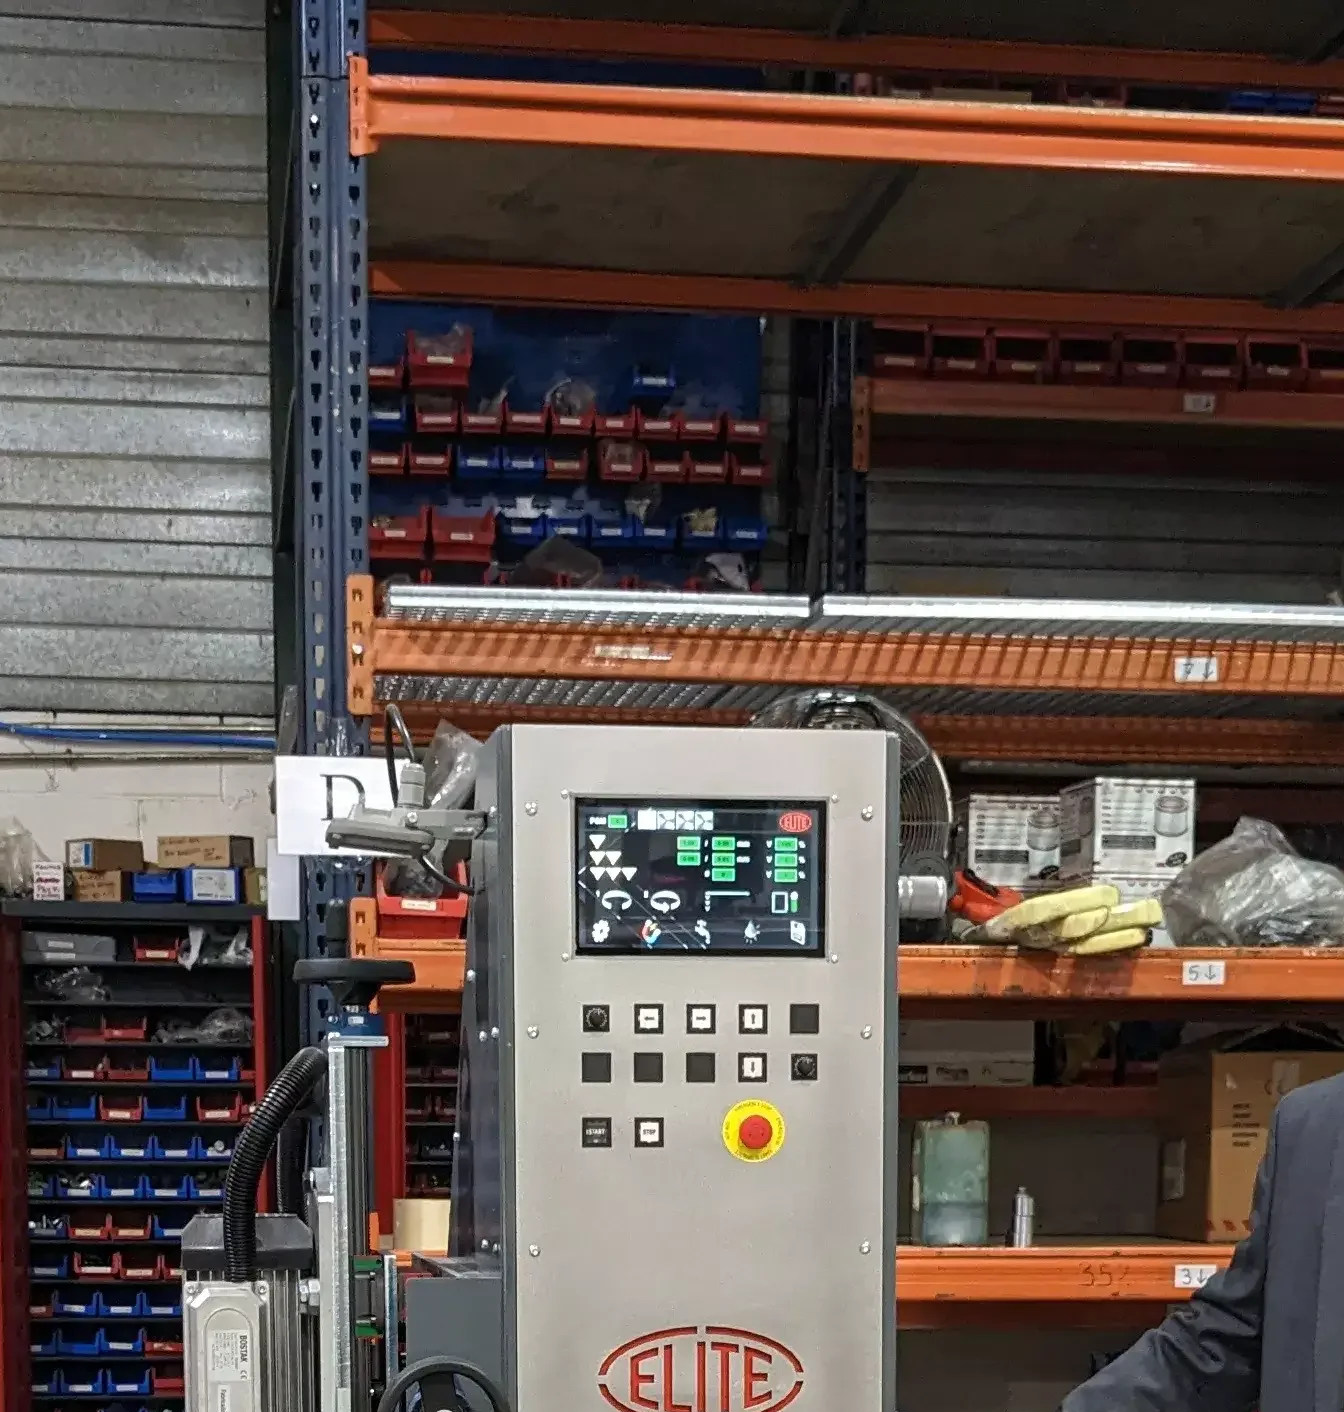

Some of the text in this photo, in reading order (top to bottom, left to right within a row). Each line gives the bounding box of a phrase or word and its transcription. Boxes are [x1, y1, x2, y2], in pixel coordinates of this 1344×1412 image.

[1188, 964, 1201, 981] 5
[642, 1128, 657, 1136] STOP
[1178, 1268, 1192, 1285] 3
[239, 1335, 248, 1362] BOSTAK
